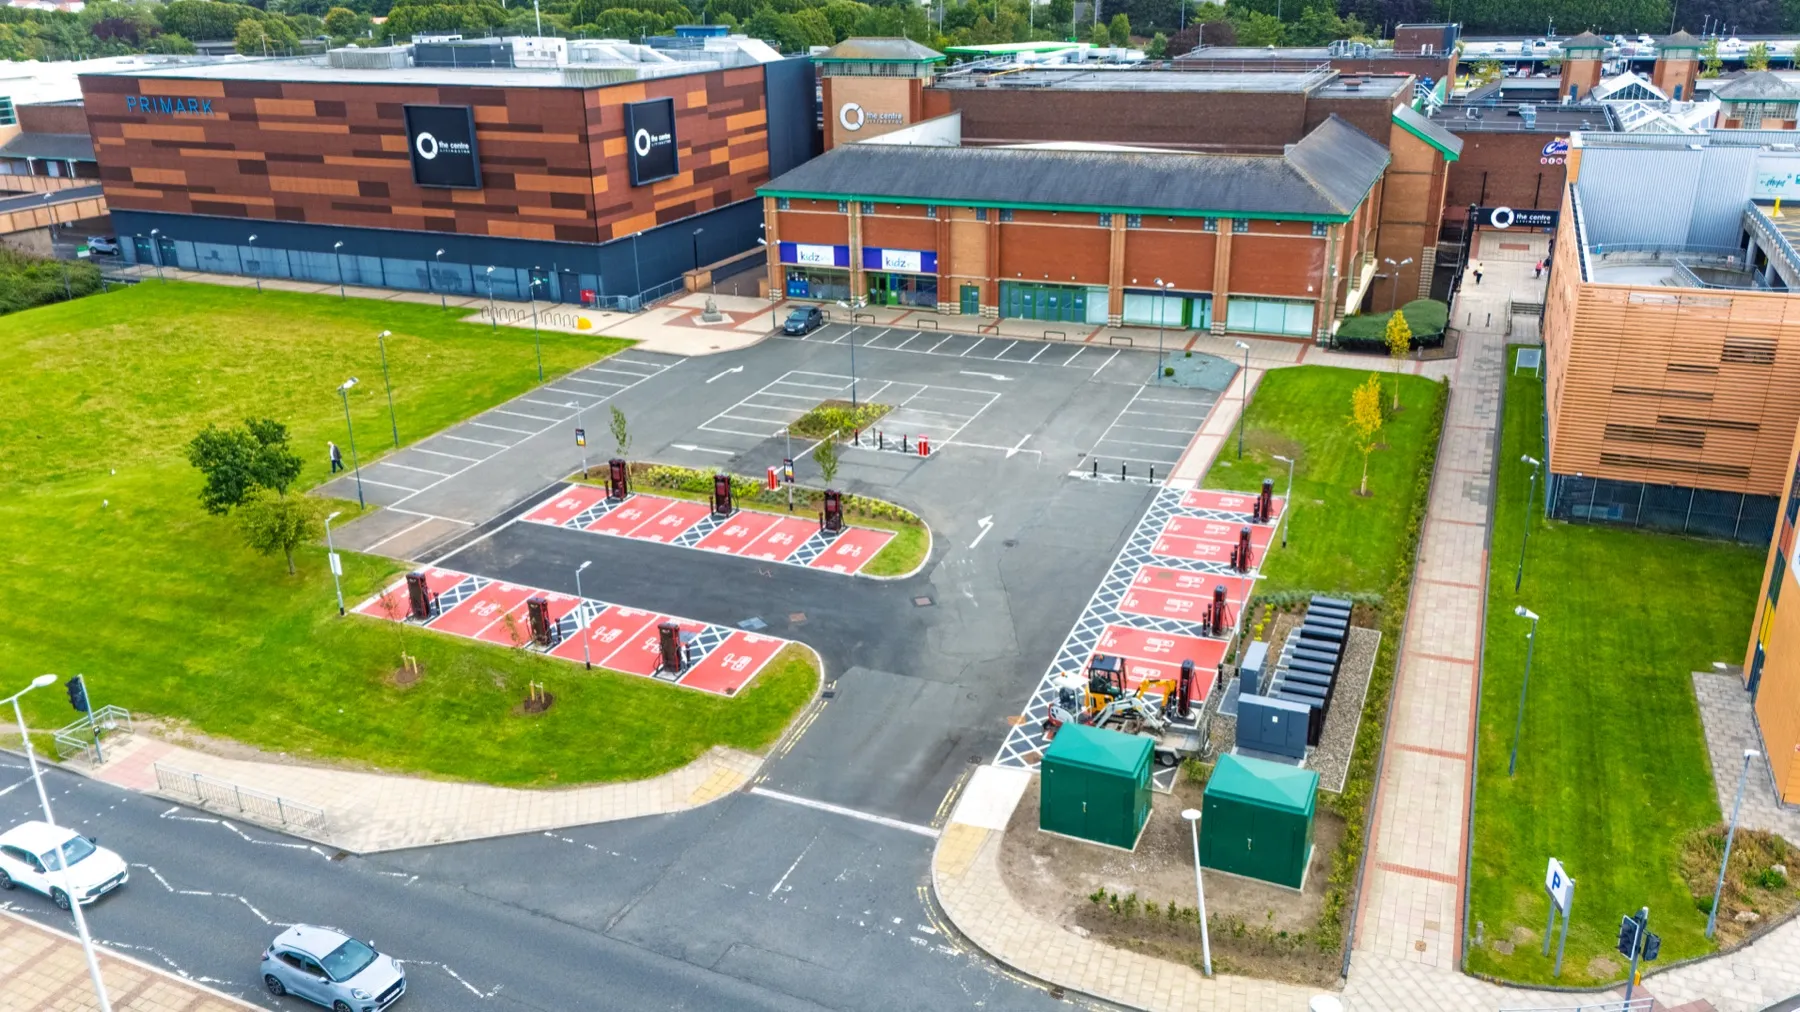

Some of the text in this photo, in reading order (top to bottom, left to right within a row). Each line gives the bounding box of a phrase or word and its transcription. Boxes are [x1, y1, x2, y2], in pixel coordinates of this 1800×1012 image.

[126, 95, 214, 116] PRIMARK
[879, 112, 903, 120] centre
[438, 140, 469, 150] the centre
[1516, 212, 1527, 220] the
[800, 251, 820, 262] kidz
[886, 256, 906, 268] kidz
[1551, 870, 1561, 890] P
